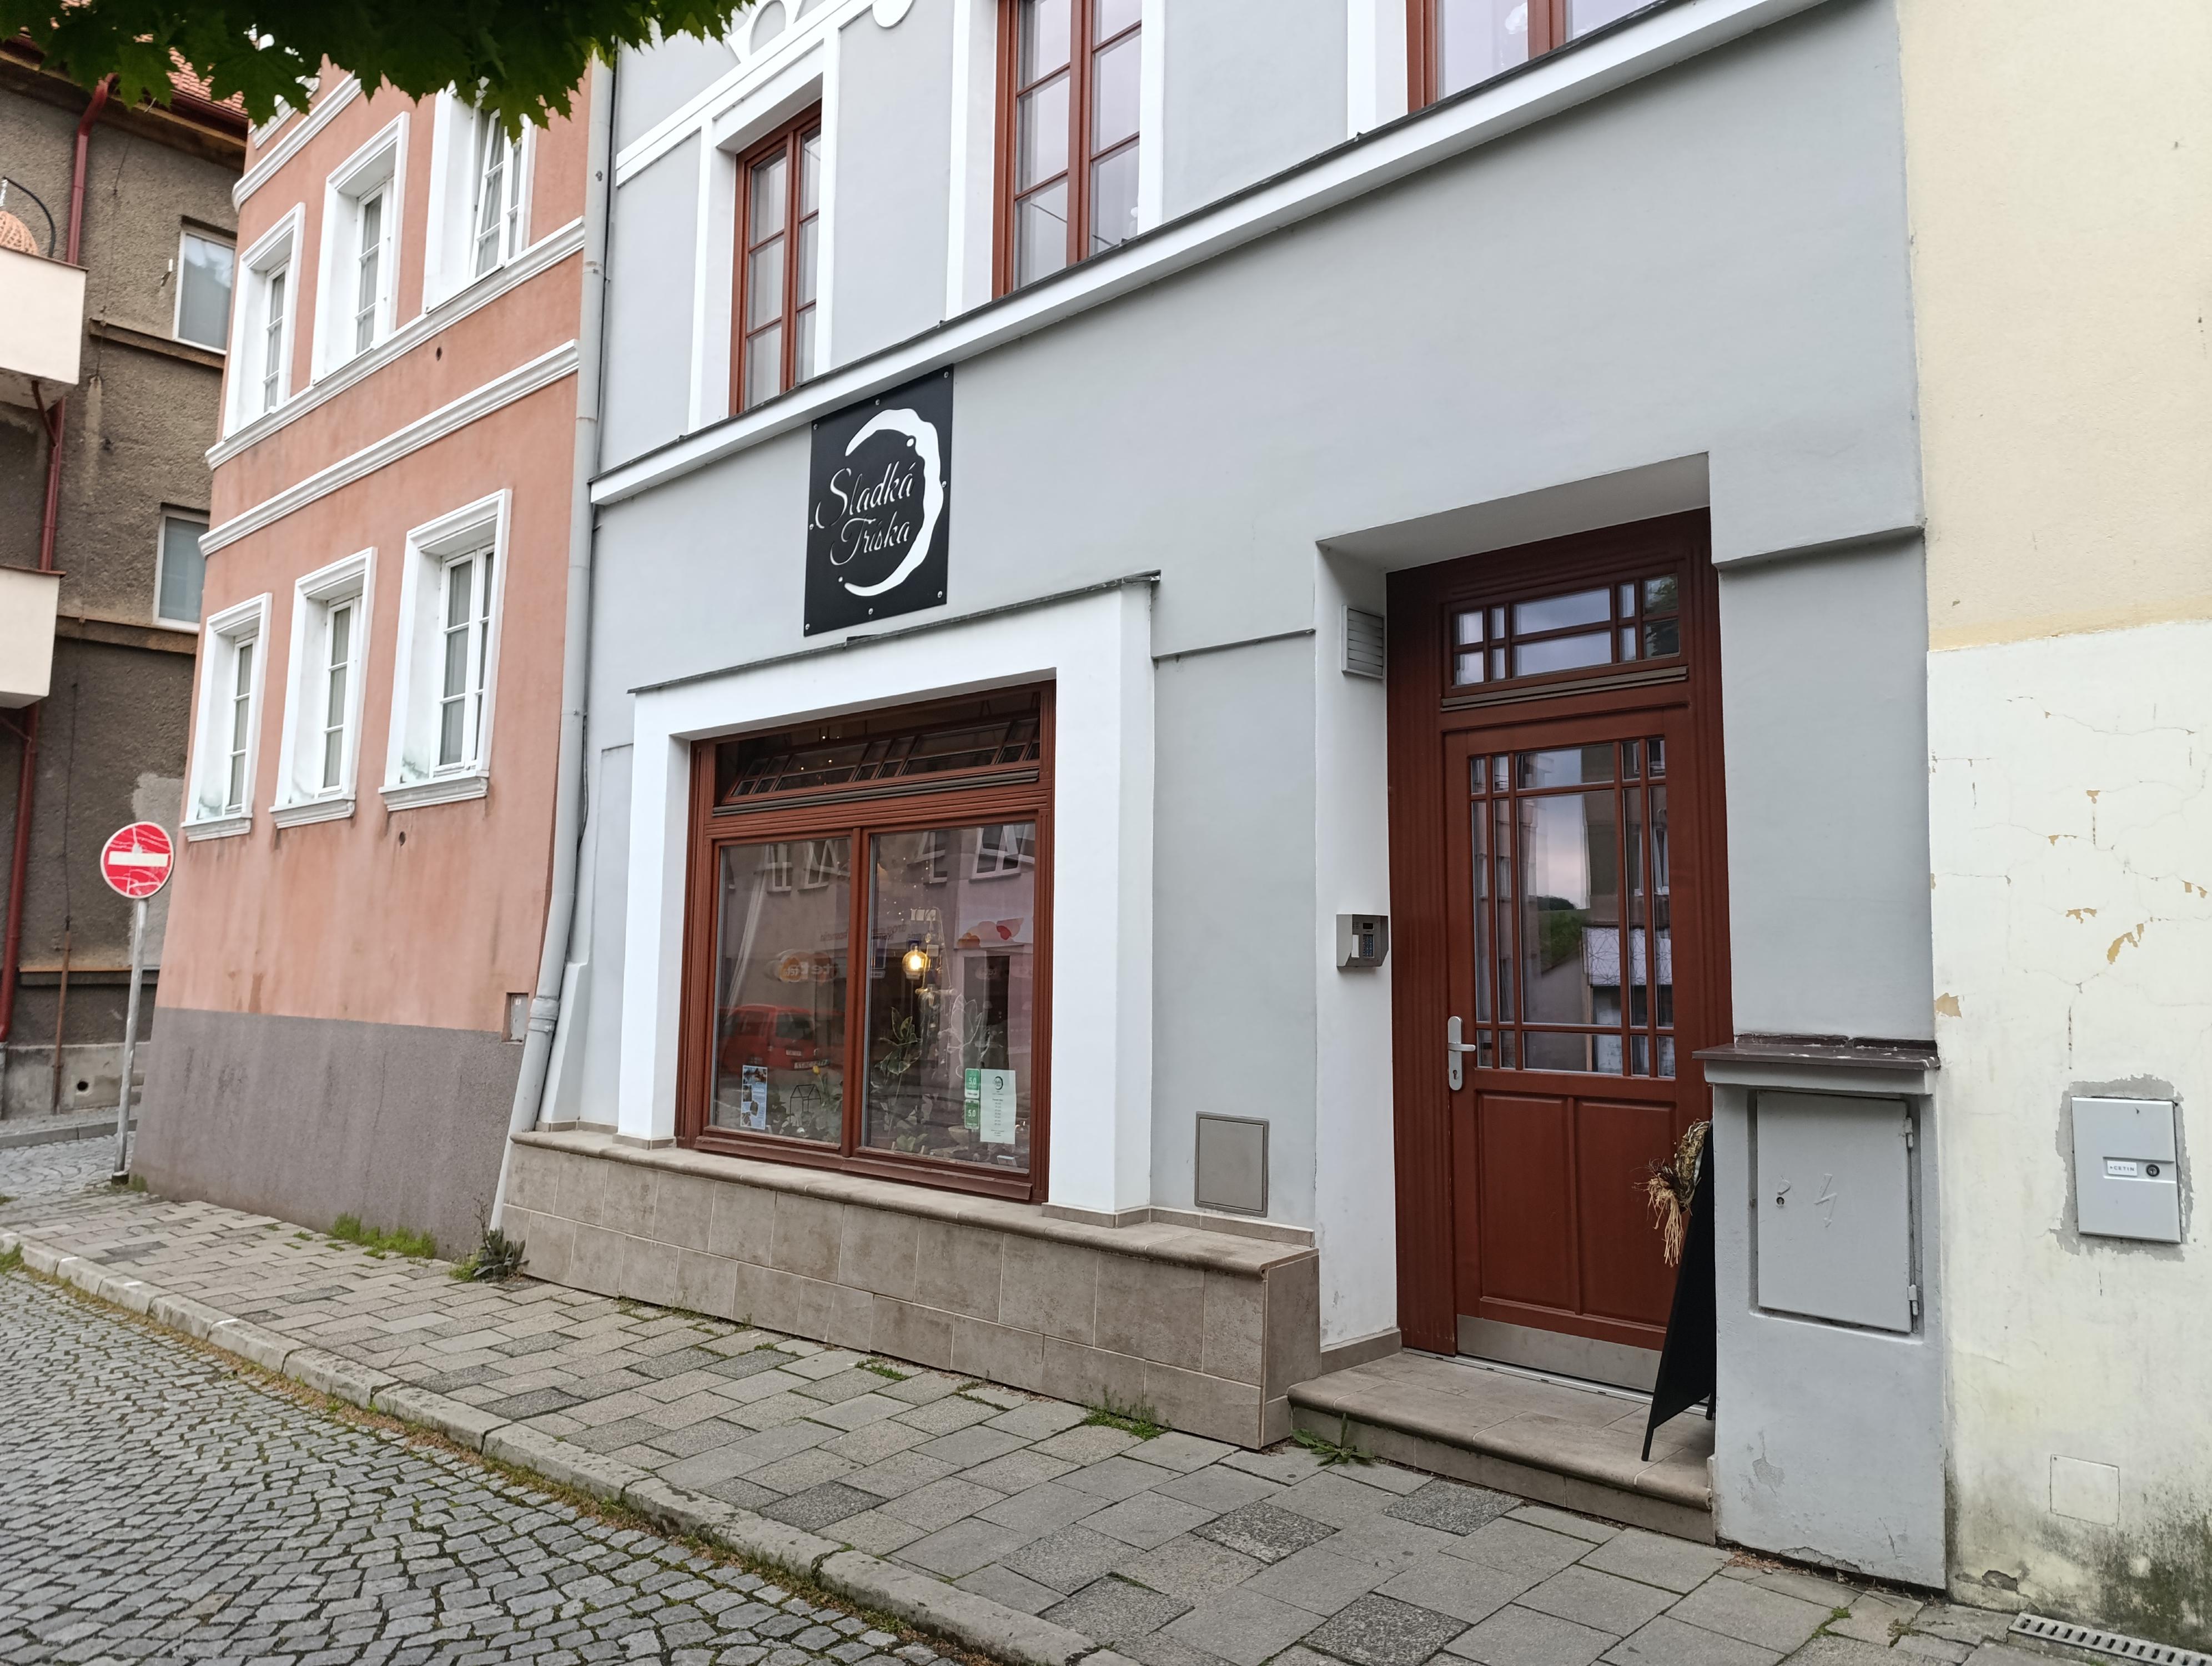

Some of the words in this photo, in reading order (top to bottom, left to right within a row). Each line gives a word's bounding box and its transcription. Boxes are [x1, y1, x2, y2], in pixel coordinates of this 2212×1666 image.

[816, 460, 916, 529] Sladká
[968, 1077, 977, 1086] 5,0
[968, 1109, 976, 1118] 5,0
